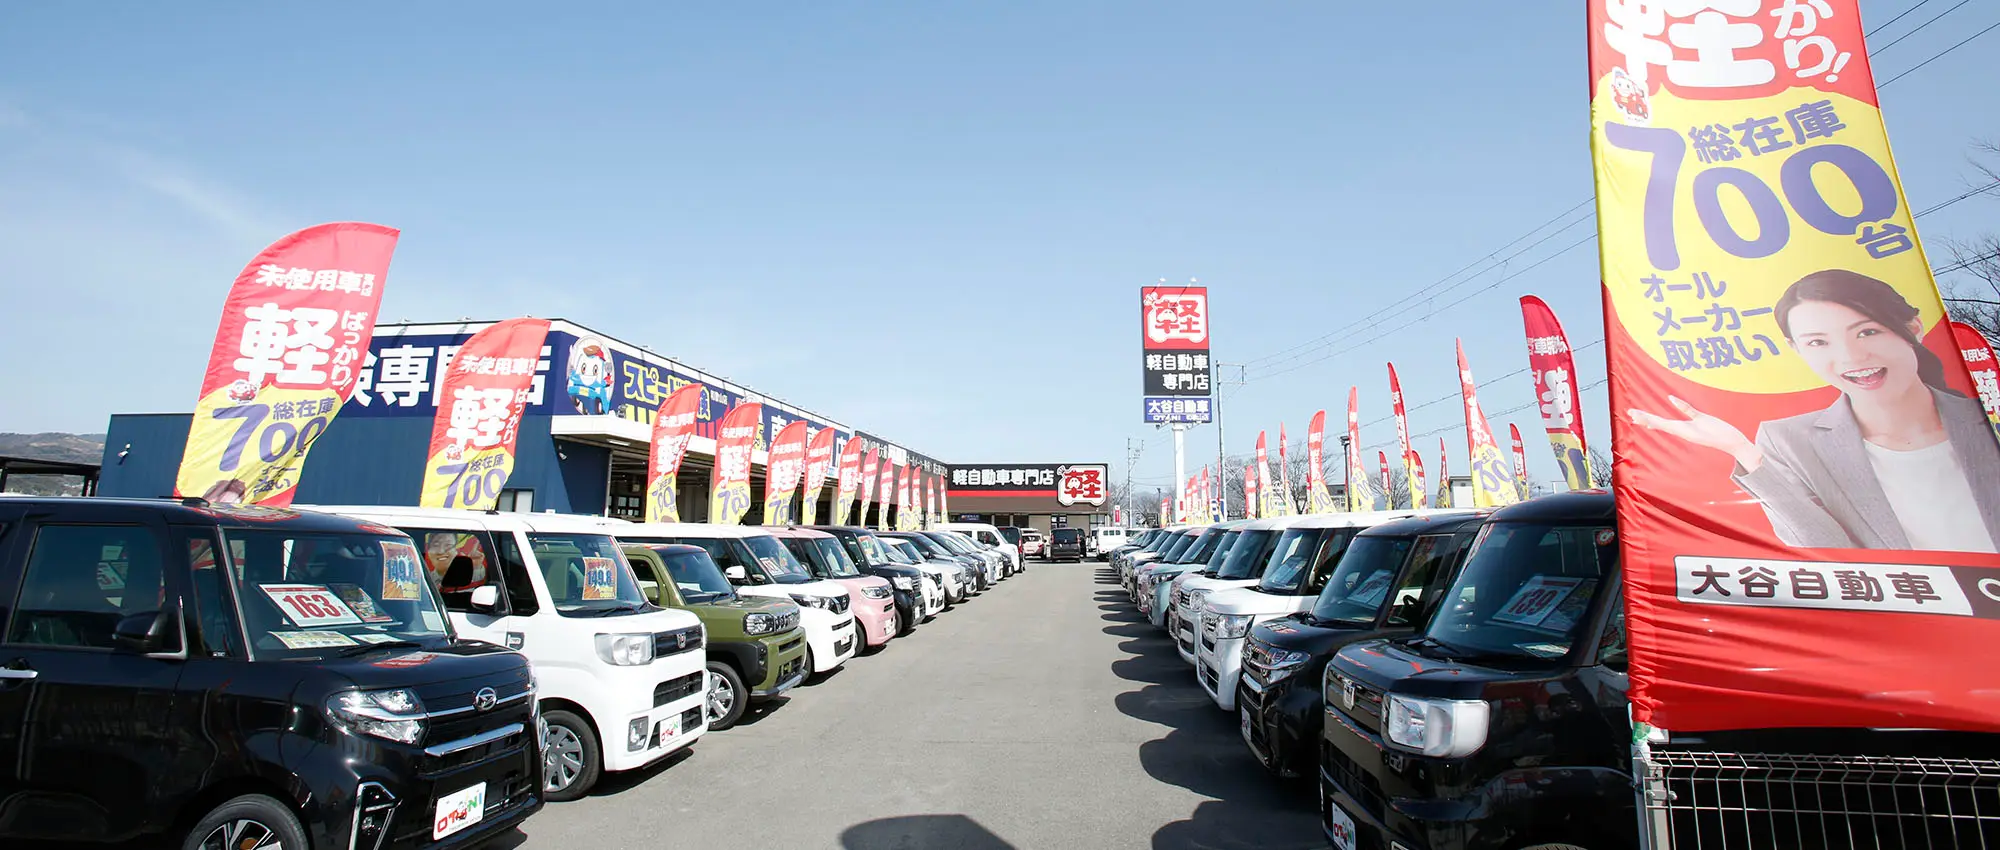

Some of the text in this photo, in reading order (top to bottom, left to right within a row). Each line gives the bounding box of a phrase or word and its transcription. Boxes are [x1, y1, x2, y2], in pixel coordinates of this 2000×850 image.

[1604, 0, 1776, 89] 軽
[1688, 99, 1846, 165] 総在庫
[1604, 121, 1898, 272] 700
[1855, 222, 1914, 260] 台
[1639, 271, 1727, 303] オール
[1652, 303, 1773, 337] メーカー
[233, 302, 338, 386] 軽
[1146, 354, 1208, 371] 軽自動車
[1659, 333, 1780, 371] 取扱い
[1162, 373, 1209, 390] 専門店
[272, 397, 336, 420] 総在庫
[446, 385, 514, 446] 軽
[1148, 400, 1209, 413] 大谷自動車
[212, 404, 327, 471] 700
[436, 462, 507, 508] 700
[952, 469, 1055, 486] 軽自動車専門店
[1064, 470, 1102, 498] 軽
[1690, 564, 1942, 604] 大谷自動車
[282, 594, 341, 618] 163
